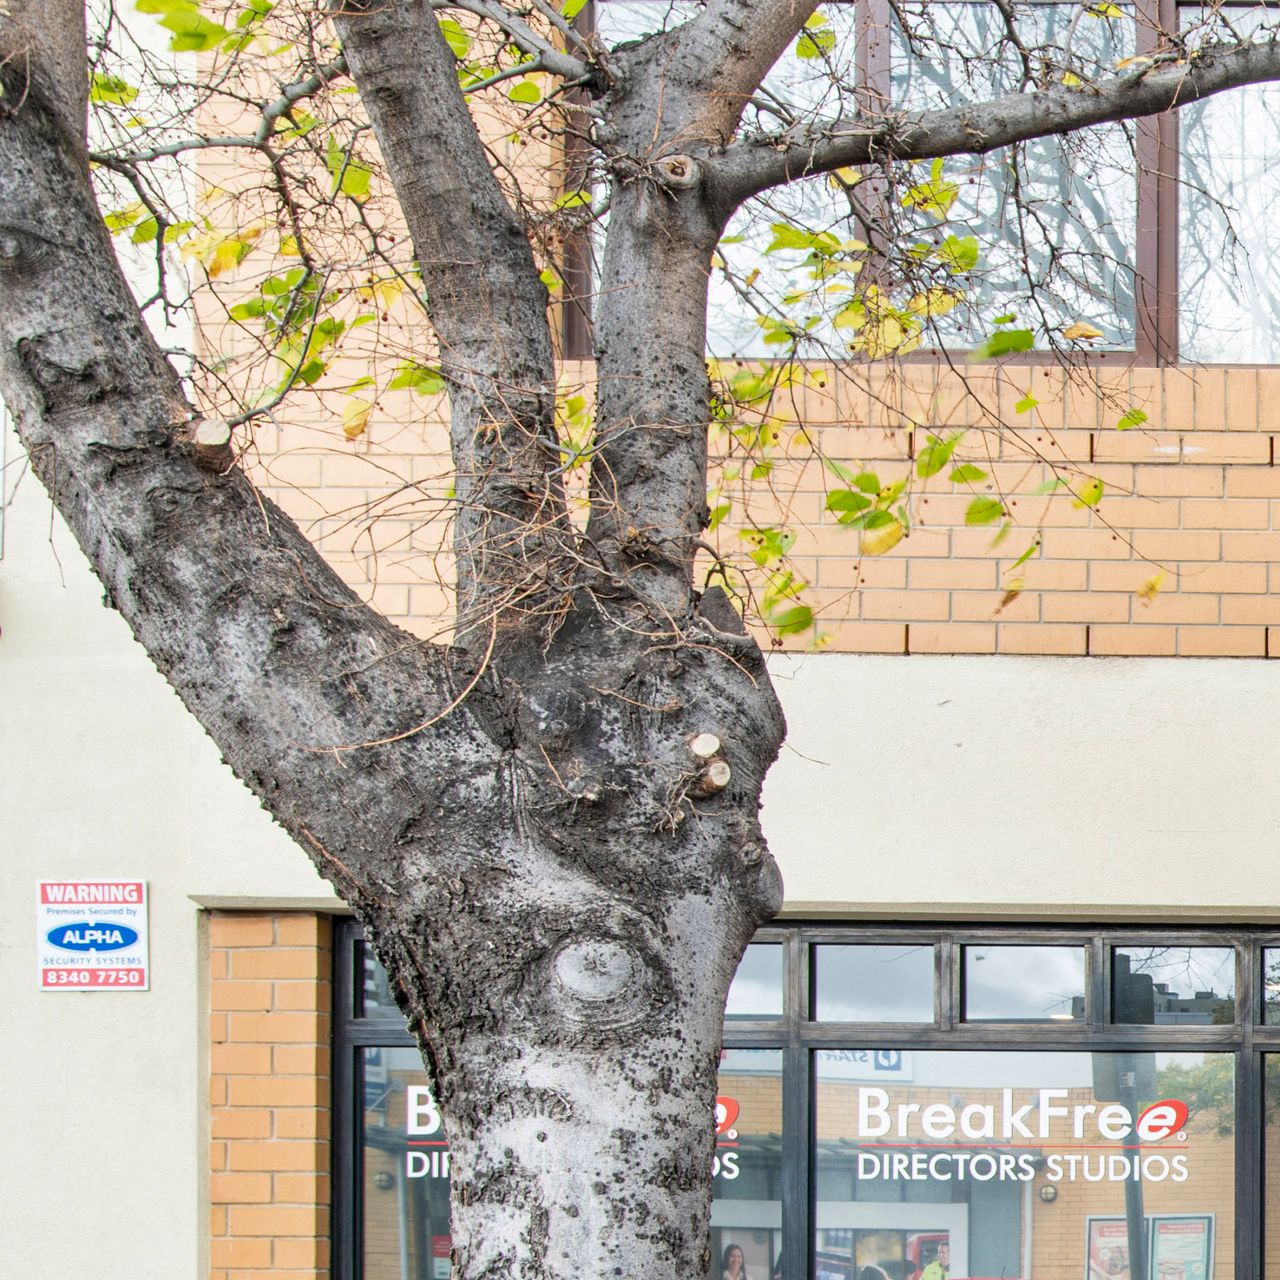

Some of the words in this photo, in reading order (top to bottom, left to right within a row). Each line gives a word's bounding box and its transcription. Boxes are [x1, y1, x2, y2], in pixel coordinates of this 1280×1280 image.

[45, 884, 138, 903] WARNING
[46, 907, 86, 915] Premises
[88, 907, 123, 915] Secured
[126, 907, 137, 917] by
[62, 930, 124, 944] ALPHA
[44, 957, 91, 966] SECURITY
[96, 957, 143, 966] SYSTEMS
[46, 971, 90, 983] 8340
[96, 971, 140, 983] 7750
[858, 1087, 1190, 1141] BreakFree
[858, 1153, 1036, 1182] DIRECTORS
[1046, 1153, 1189, 1182] STUDIOS
